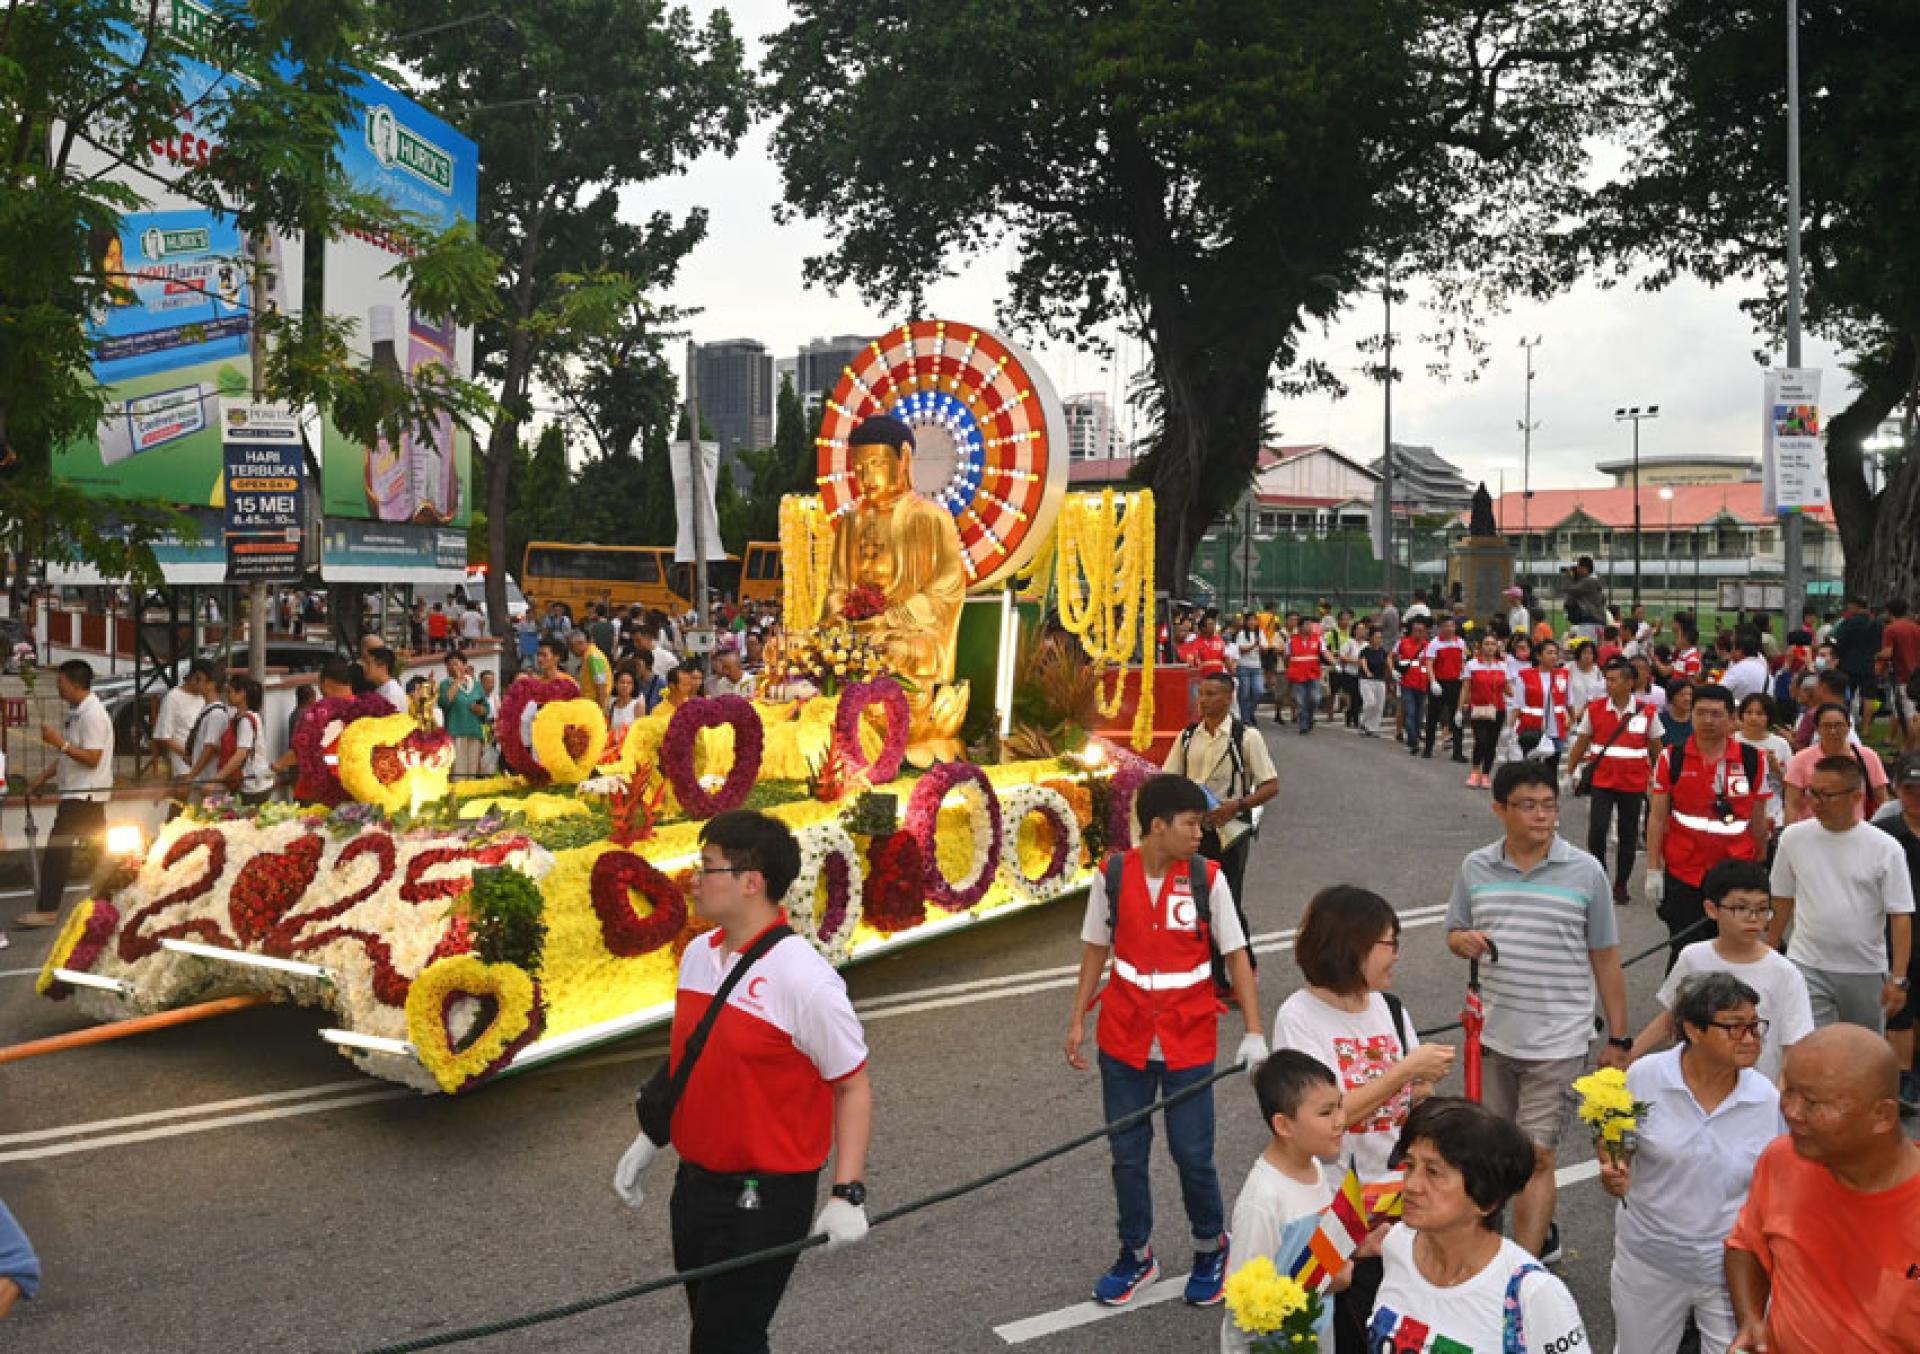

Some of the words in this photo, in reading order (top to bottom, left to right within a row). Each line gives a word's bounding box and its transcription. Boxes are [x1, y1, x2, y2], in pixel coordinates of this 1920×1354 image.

[245, 451, 281, 463] HARI
[230, 465, 298, 477] TERBUKA
[234, 496, 256, 512] 15
[260, 496, 294, 512] MEI
